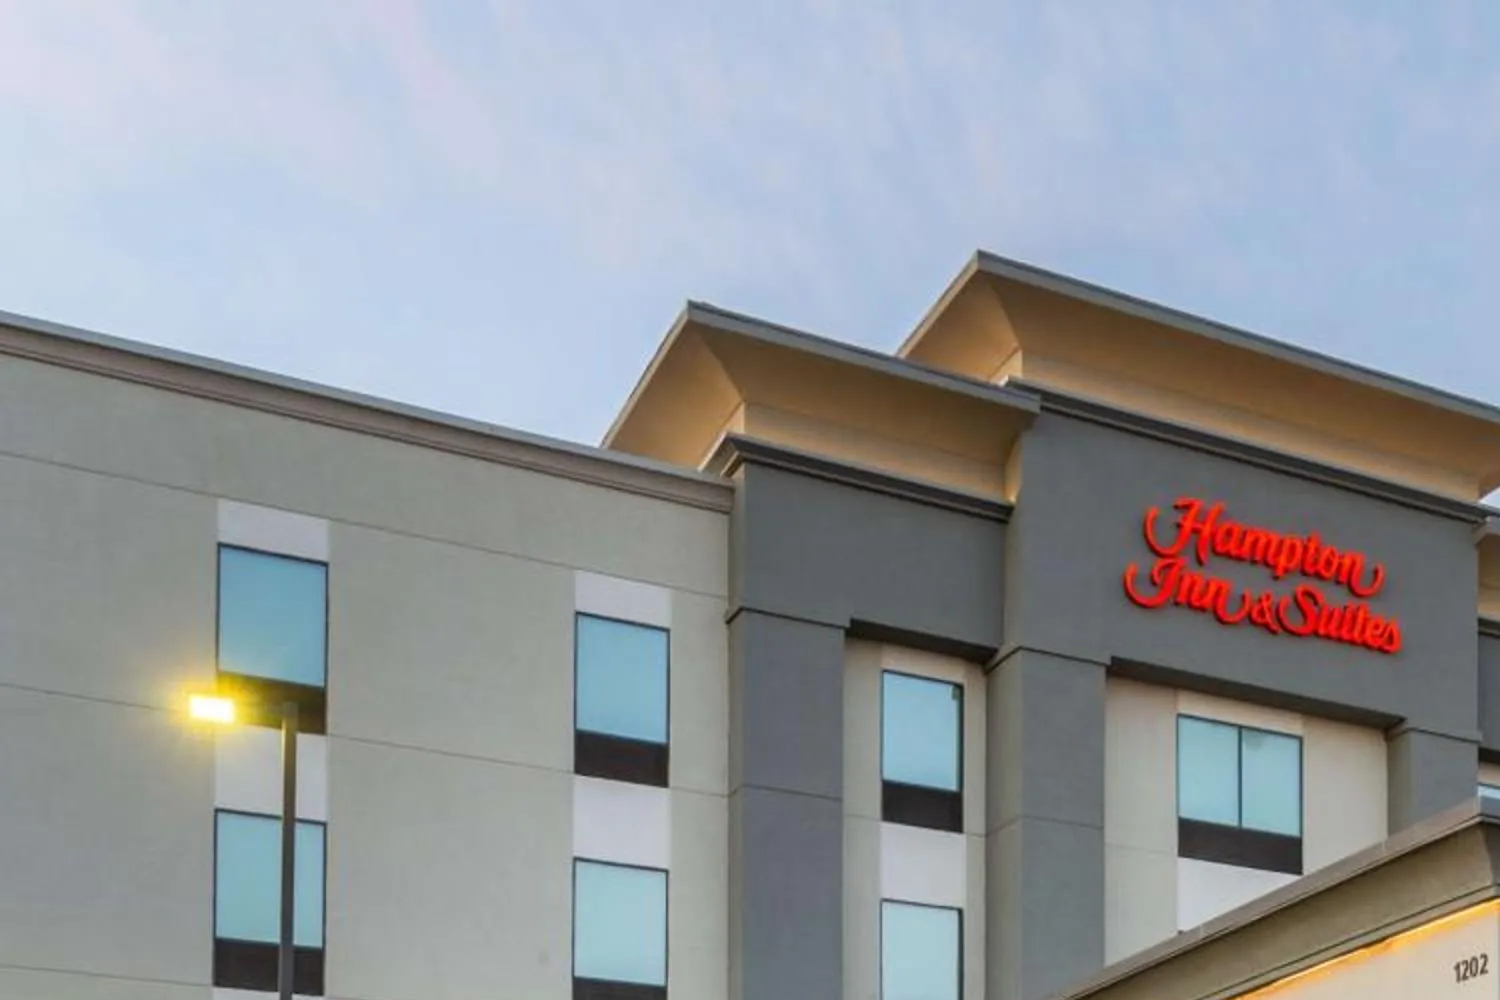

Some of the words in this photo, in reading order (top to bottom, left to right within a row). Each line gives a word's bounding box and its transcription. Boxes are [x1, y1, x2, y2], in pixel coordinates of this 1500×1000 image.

[1144, 497, 1385, 597] Hampton
[1123, 557, 1250, 625] Inn
[1250, 590, 1281, 635] &
[1278, 585, 1401, 654] Suites
[1453, 953, 1489, 983] 1202
